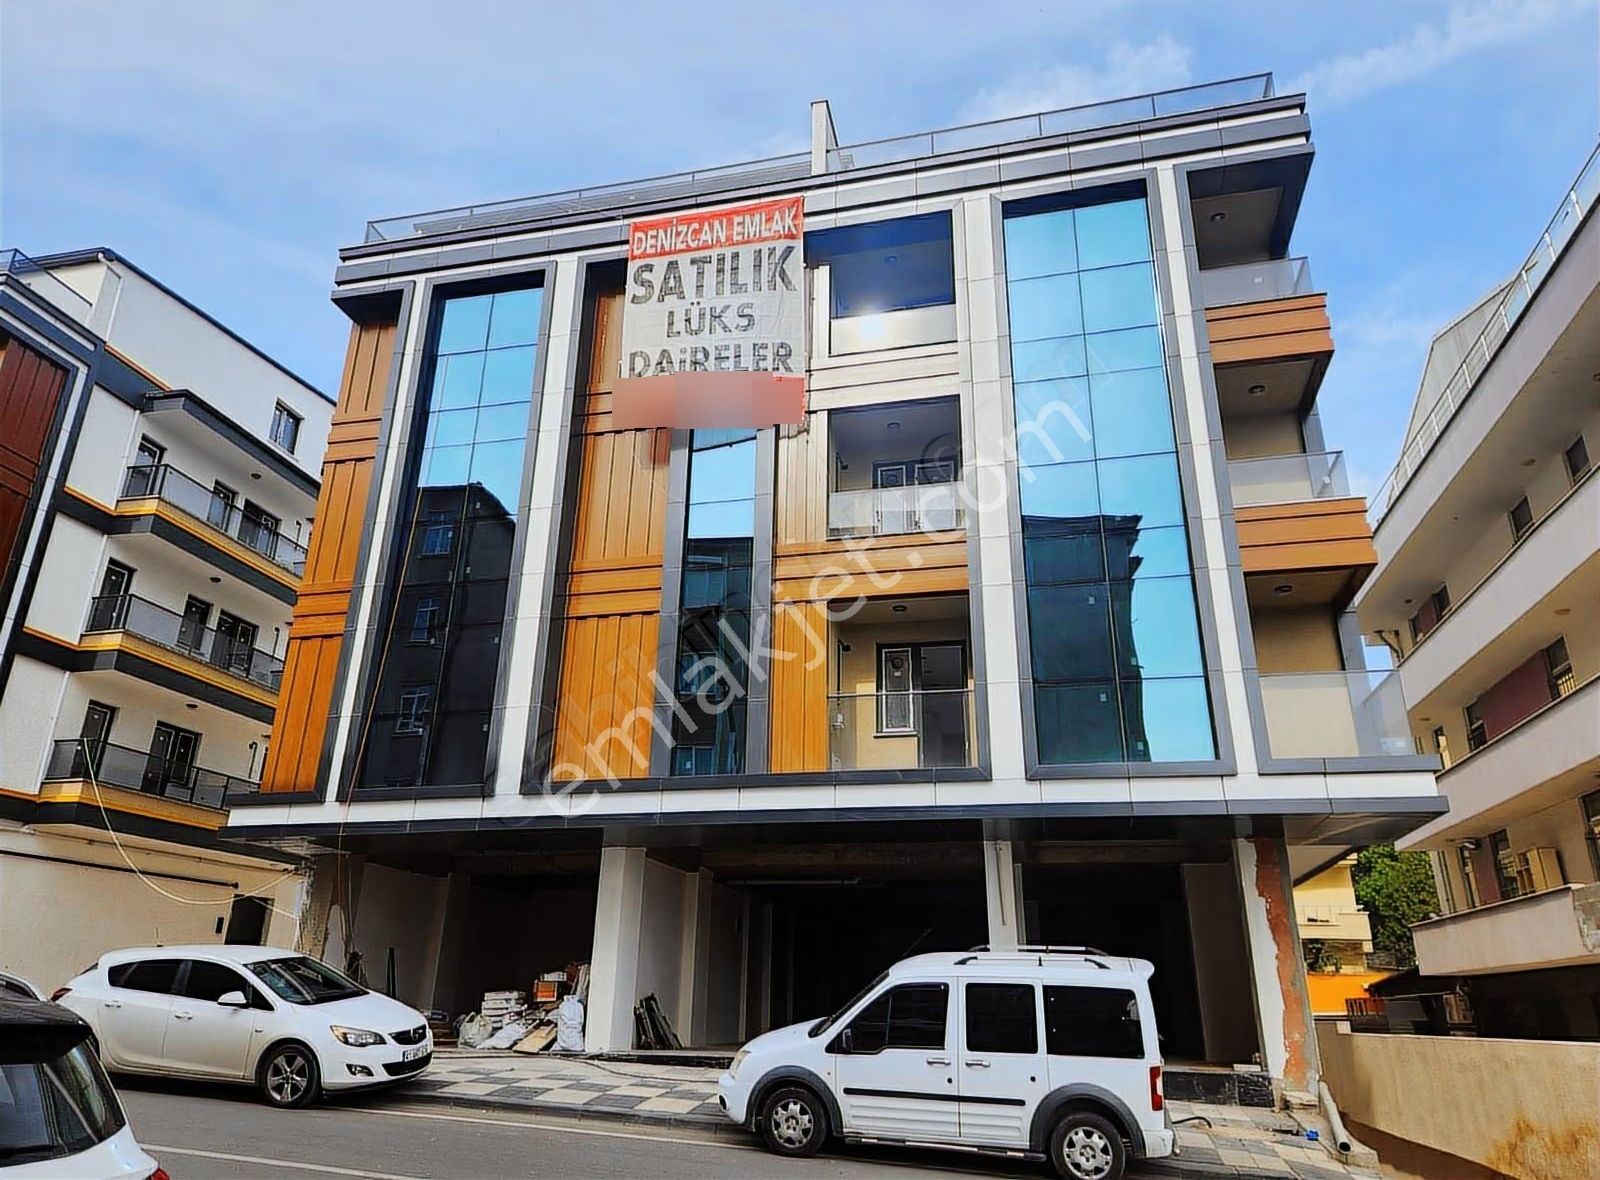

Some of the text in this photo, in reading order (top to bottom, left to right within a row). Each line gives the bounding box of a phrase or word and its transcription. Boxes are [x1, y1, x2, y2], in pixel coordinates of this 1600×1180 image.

[633, 206, 797, 256] DENİZCAN EMLAK
[631, 246, 797, 304] SATILIK
[666, 301, 755, 338] LÜKS
